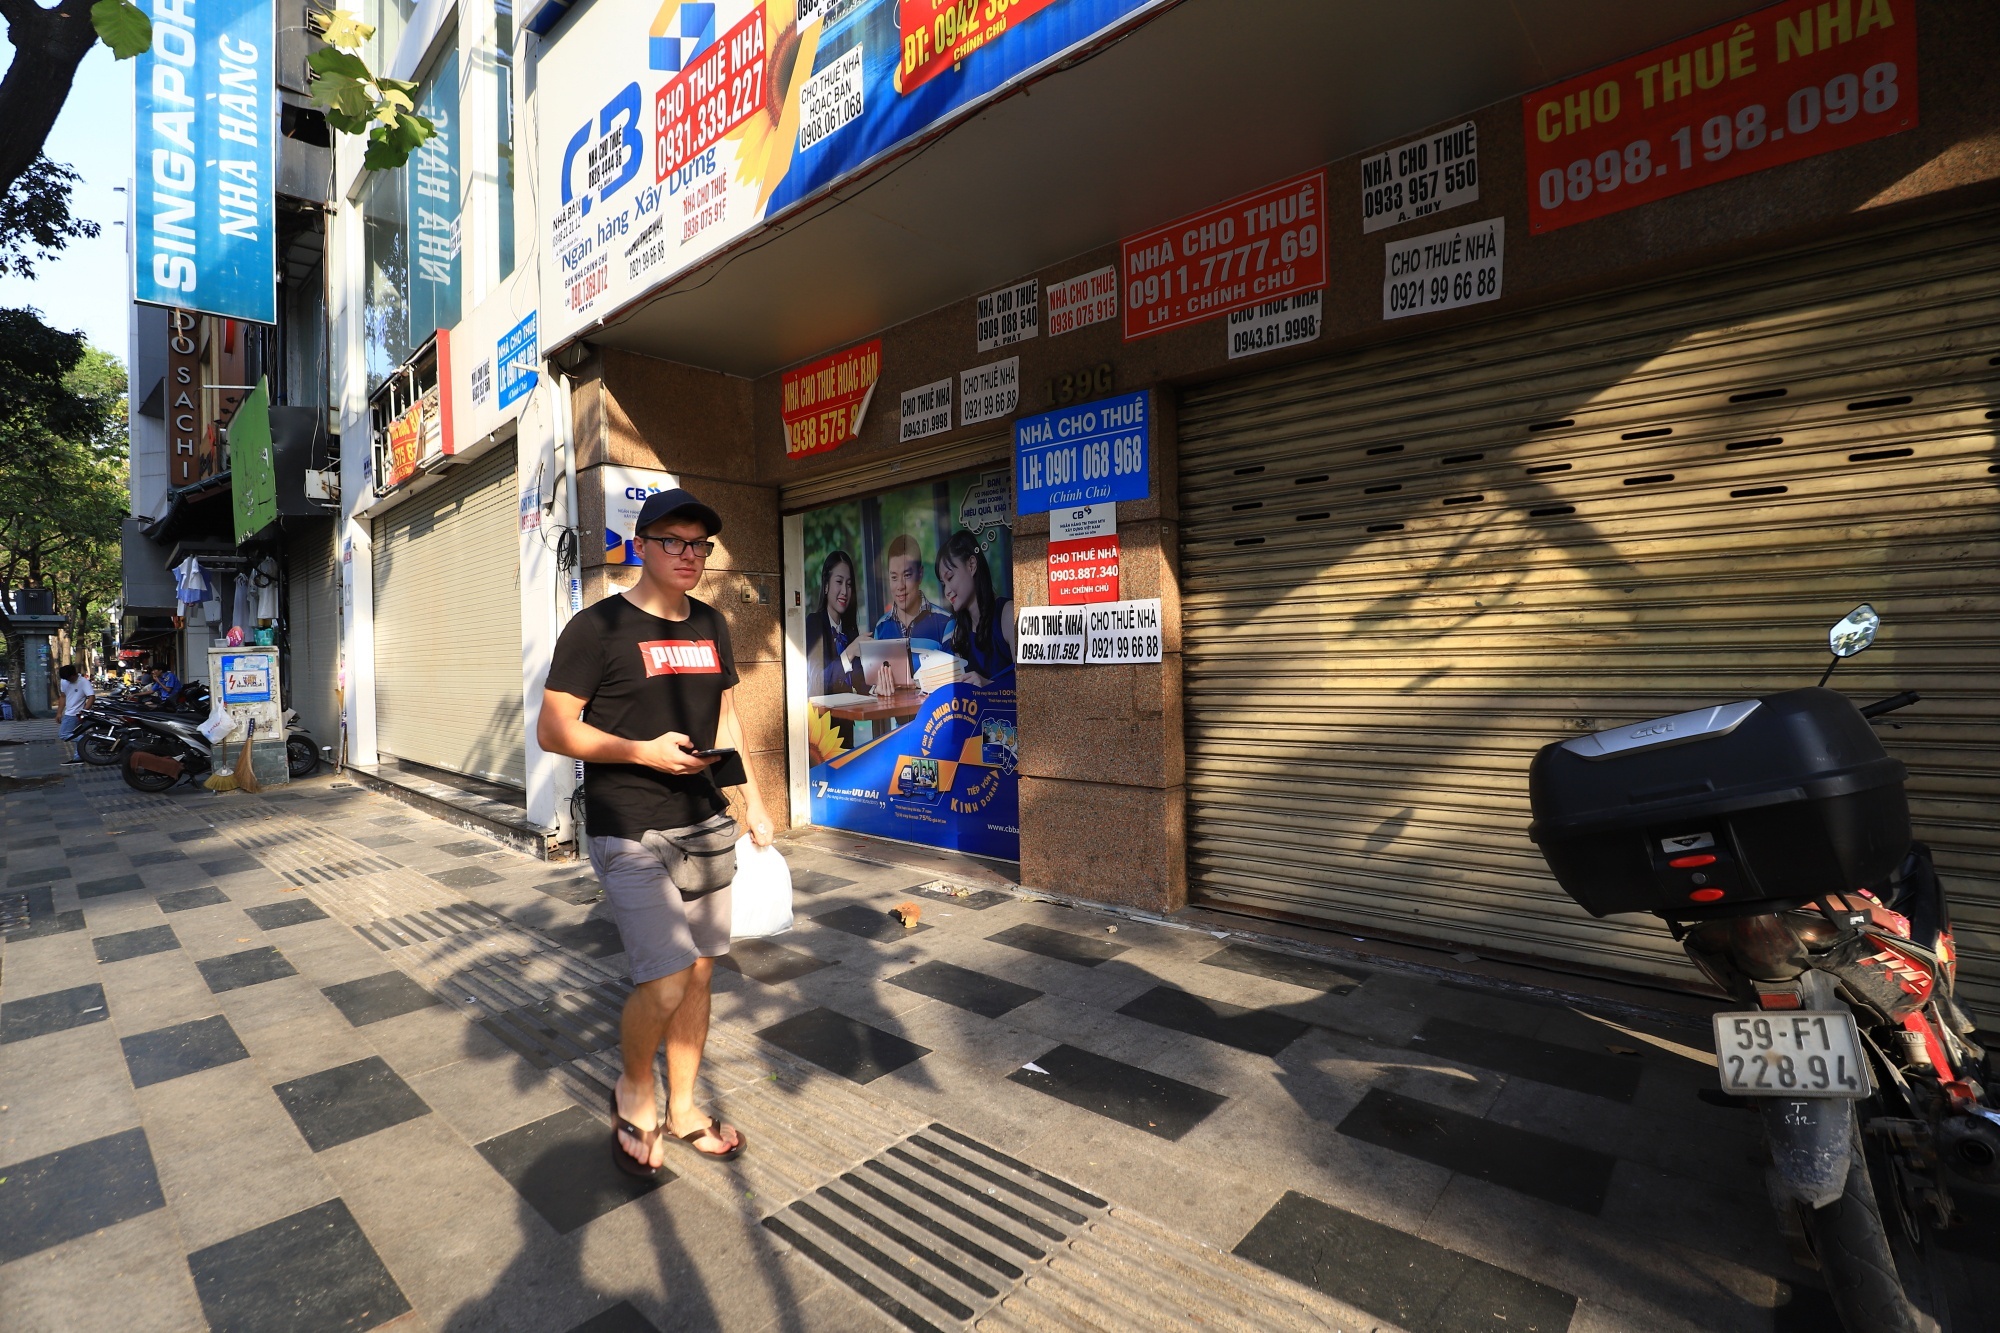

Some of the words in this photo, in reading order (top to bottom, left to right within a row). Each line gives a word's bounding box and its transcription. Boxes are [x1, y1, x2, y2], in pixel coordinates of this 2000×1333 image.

[904, 25, 930, 76] ĐT:
[934, 0, 980, 54] 0942
[953, 35, 984, 61] CHÍNH
[985, 14, 1007, 42] CHỦ
[206, 33, 259, 146] HÀNG
[656, 82, 685, 133] CHO
[688, 39, 726, 108] THUÊ
[731, 10, 765, 75] NHÀ
[801, 82, 818, 105] CHO
[819, 58, 841, 92] THUÊ
[843, 47, 860, 76] NHÀ
[834, 76, 852, 105] BÁN
[1536, 80, 1621, 144] CHO
[1635, 23, 1757, 111] THUÊ
[657, 58, 764, 178] 0931.339.227
[801, 91, 862, 149] 0908.061.068
[1539, 61, 1900, 211] 0898.198.098
[1363, 151, 1393, 190] NHÀ
[1399, 143, 1428, 177] CHO
[1433, 122, 1476, 165] THUÊ
[206, 159, 258, 242] NHÀ
[597, 209, 629, 248] hàng
[634, 184, 662, 221] Xây
[669, 146, 716, 197] Dựng
[682, 188, 696, 217] NHÀ
[697, 183, 710, 209] CHO
[1364, 182, 1403, 219] 0933
[1408, 169, 1439, 206] 957
[1444, 157, 1477, 194] 550
[553, 207, 567, 232] NHÀ
[683, 212, 699, 240] 0936
[700, 206, 713, 232] 075
[1130, 238, 1175, 275] NHÀ
[1182, 217, 1235, 257] CHO
[1243, 183, 1316, 236] THUÊ
[1397, 211, 1411, 223] A.
[1415, 200, 1443, 217] HUY
[1129, 224, 1318, 310] 0911.7777.69
[1391, 248, 1421, 277] CHO
[1424, 232, 1462, 270] THUÊ
[1464, 225, 1497, 263] NHÀ
[978, 293, 994, 319] NHÀ
[997, 291, 1012, 313] CHO
[1016, 279, 1037, 308] THUÊ
[1050, 283, 1067, 312] NHÀ
[1069, 280, 1088, 305] CHO
[1090, 265, 1115, 298] THUÊ
[1187, 282, 1246, 313] CHÍNH
[1253, 263, 1296, 294] CHỦ
[1390, 278, 1425, 312] 0921
[1430, 275, 1449, 306] 99
[1453, 270, 1473, 302] 66
[1477, 266, 1496, 297] 88
[978, 318, 999, 342] 0909
[1001, 311, 1018, 335] 088
[1020, 305, 1038, 330] 540
[1050, 313, 1073, 335] 0936
[1076, 303, 1094, 327] 075
[1096, 296, 1116, 320] 915
[1233, 314, 1316, 353] 0943.61.9998
[784, 373, 799, 413] NHÀ
[800, 378, 816, 407] CHO
[816, 361, 837, 403] THUÊ
[837, 354, 859, 401] HOẶC
[859, 346, 878, 387] BÁN
[963, 376, 979, 396] CHO
[979, 365, 999, 392] THUÊ
[1000, 360, 1016, 387] NHÀ
[902, 398, 916, 418] CHO
[916, 388, 935, 415] THUÊ
[935, 382, 950, 411] NHÀ
[964, 398, 982, 421] 0921
[984, 395, 994, 416] 99
[995, 393, 1005, 413] 66
[1006, 389, 1017, 409] 88
[174, 366, 194, 479] SACHI
[819, 407, 846, 446] 575
[903, 412, 948, 438] 0943.61.9998
[1020, 416, 1054, 446] NHÀ
[1057, 411, 1097, 438] CHO
[1100, 396, 1144, 429] THUÊ
[1022, 453, 1043, 491] LH:
[1045, 446, 1077, 487] 0901
[1082, 440, 1110, 481] 068
[1113, 434, 1142, 476] 968
[625, 487, 647, 501] CB
[1050, 487, 1082, 507] (Chính
[1085, 484, 1111, 500] Chủ)
[1072, 510, 1084, 520] CB
[1050, 553, 1070, 565] CHO
[1071, 547, 1096, 562] THUÊ
[1097, 544, 1118, 560] NHÀ
[1050, 564, 1119, 582] 0903.887.340
[1060, 586, 1071, 596] LH:
[1071, 584, 1094, 595] CHÍNH
[1094, 582, 1110, 593] CHỦ
[1020, 616, 1040, 636] CHO
[1042, 610, 1063, 636] THUÊ
[1065, 609, 1083, 636] NHÀ
[1090, 611, 1110, 631] CHO
[1111, 604, 1136, 630] THUÊ
[1137, 603, 1157, 629] NHÀ
[650, 645, 716, 670] PUMA
[1022, 642, 1081, 661] 0934.101.592
[1091, 637, 1114, 659] 0921
[1117, 636, 1129, 658] 99
[1132, 635, 1143, 657] 66
[1146, 635, 1159, 657] 88
[931, 702, 951, 721] MUA
[951, 696, 960, 712] Ô
[961, 697, 978, 716] TÔ
[864, 789, 880, 800] ĐÃI
[966, 783, 980, 796] TIẾP
[980, 774, 992, 789] VỐN
[950, 797, 979, 814] KINH
[1733, 1017, 1832, 1051] 59-F1
[1727, 1054, 1858, 1091] 228.94
